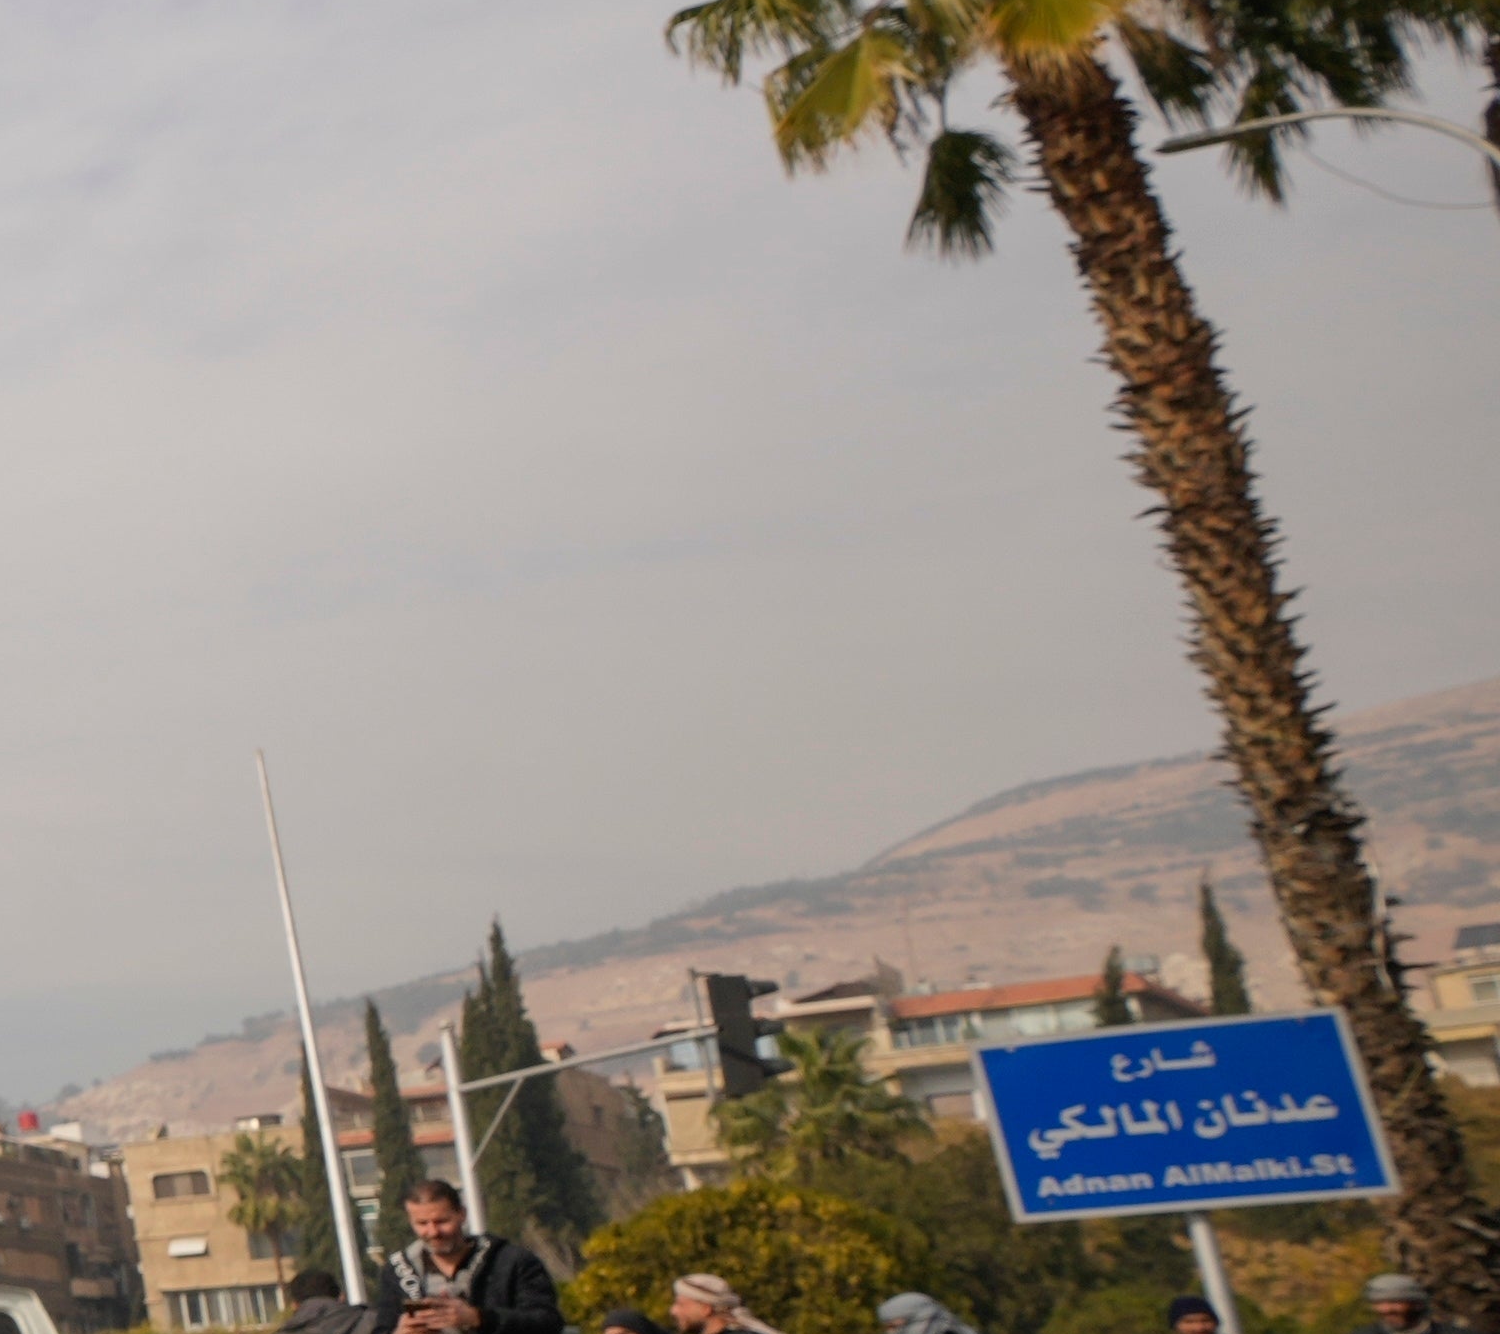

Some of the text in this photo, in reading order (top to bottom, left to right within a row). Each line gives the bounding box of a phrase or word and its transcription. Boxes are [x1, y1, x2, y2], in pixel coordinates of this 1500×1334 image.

[1110, 1040, 1216, 1083] شارع
[1028, 1090, 1339, 1160] عدنان المالكي
[1037, 1153, 1357, 1198] Adnan AlMalki.St
